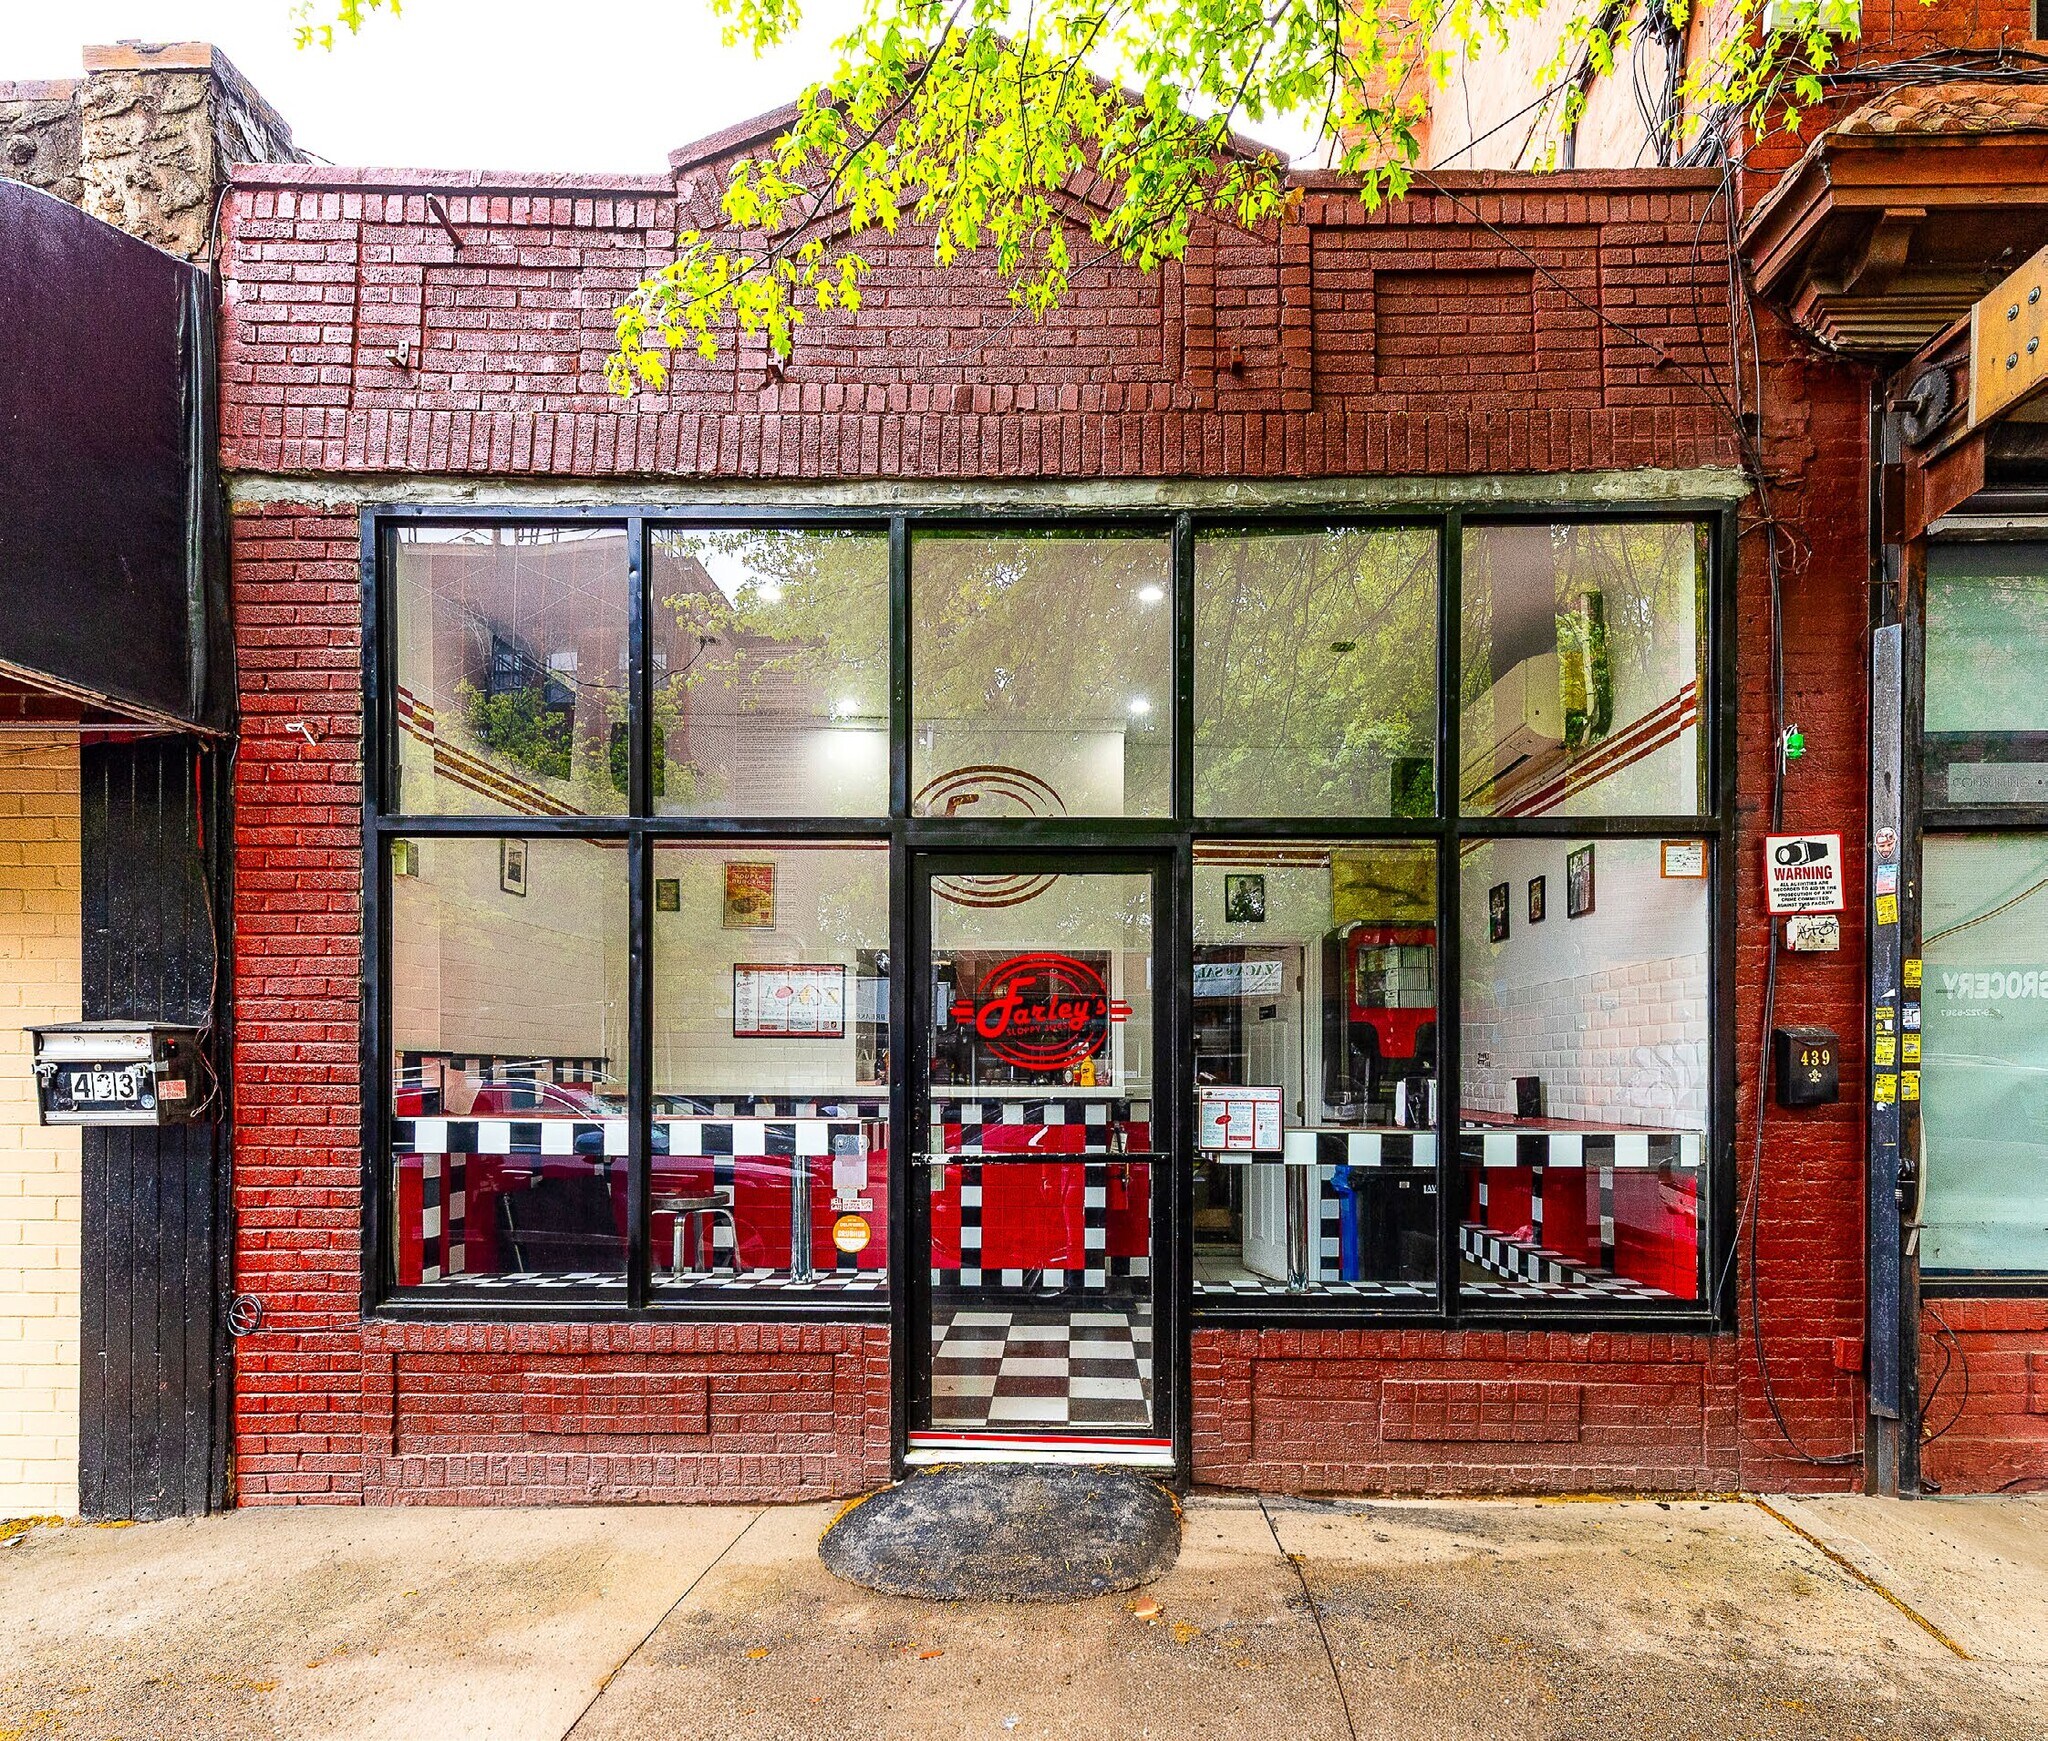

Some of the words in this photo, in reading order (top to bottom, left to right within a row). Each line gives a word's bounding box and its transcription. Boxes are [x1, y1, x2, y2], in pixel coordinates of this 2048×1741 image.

[1773, 865, 1833, 881] WARNING
[975, 976, 1108, 1039] Farley's
[1006, 1025, 1041, 1037] SLOPPY
[1800, 1049, 1831, 1066] 439
